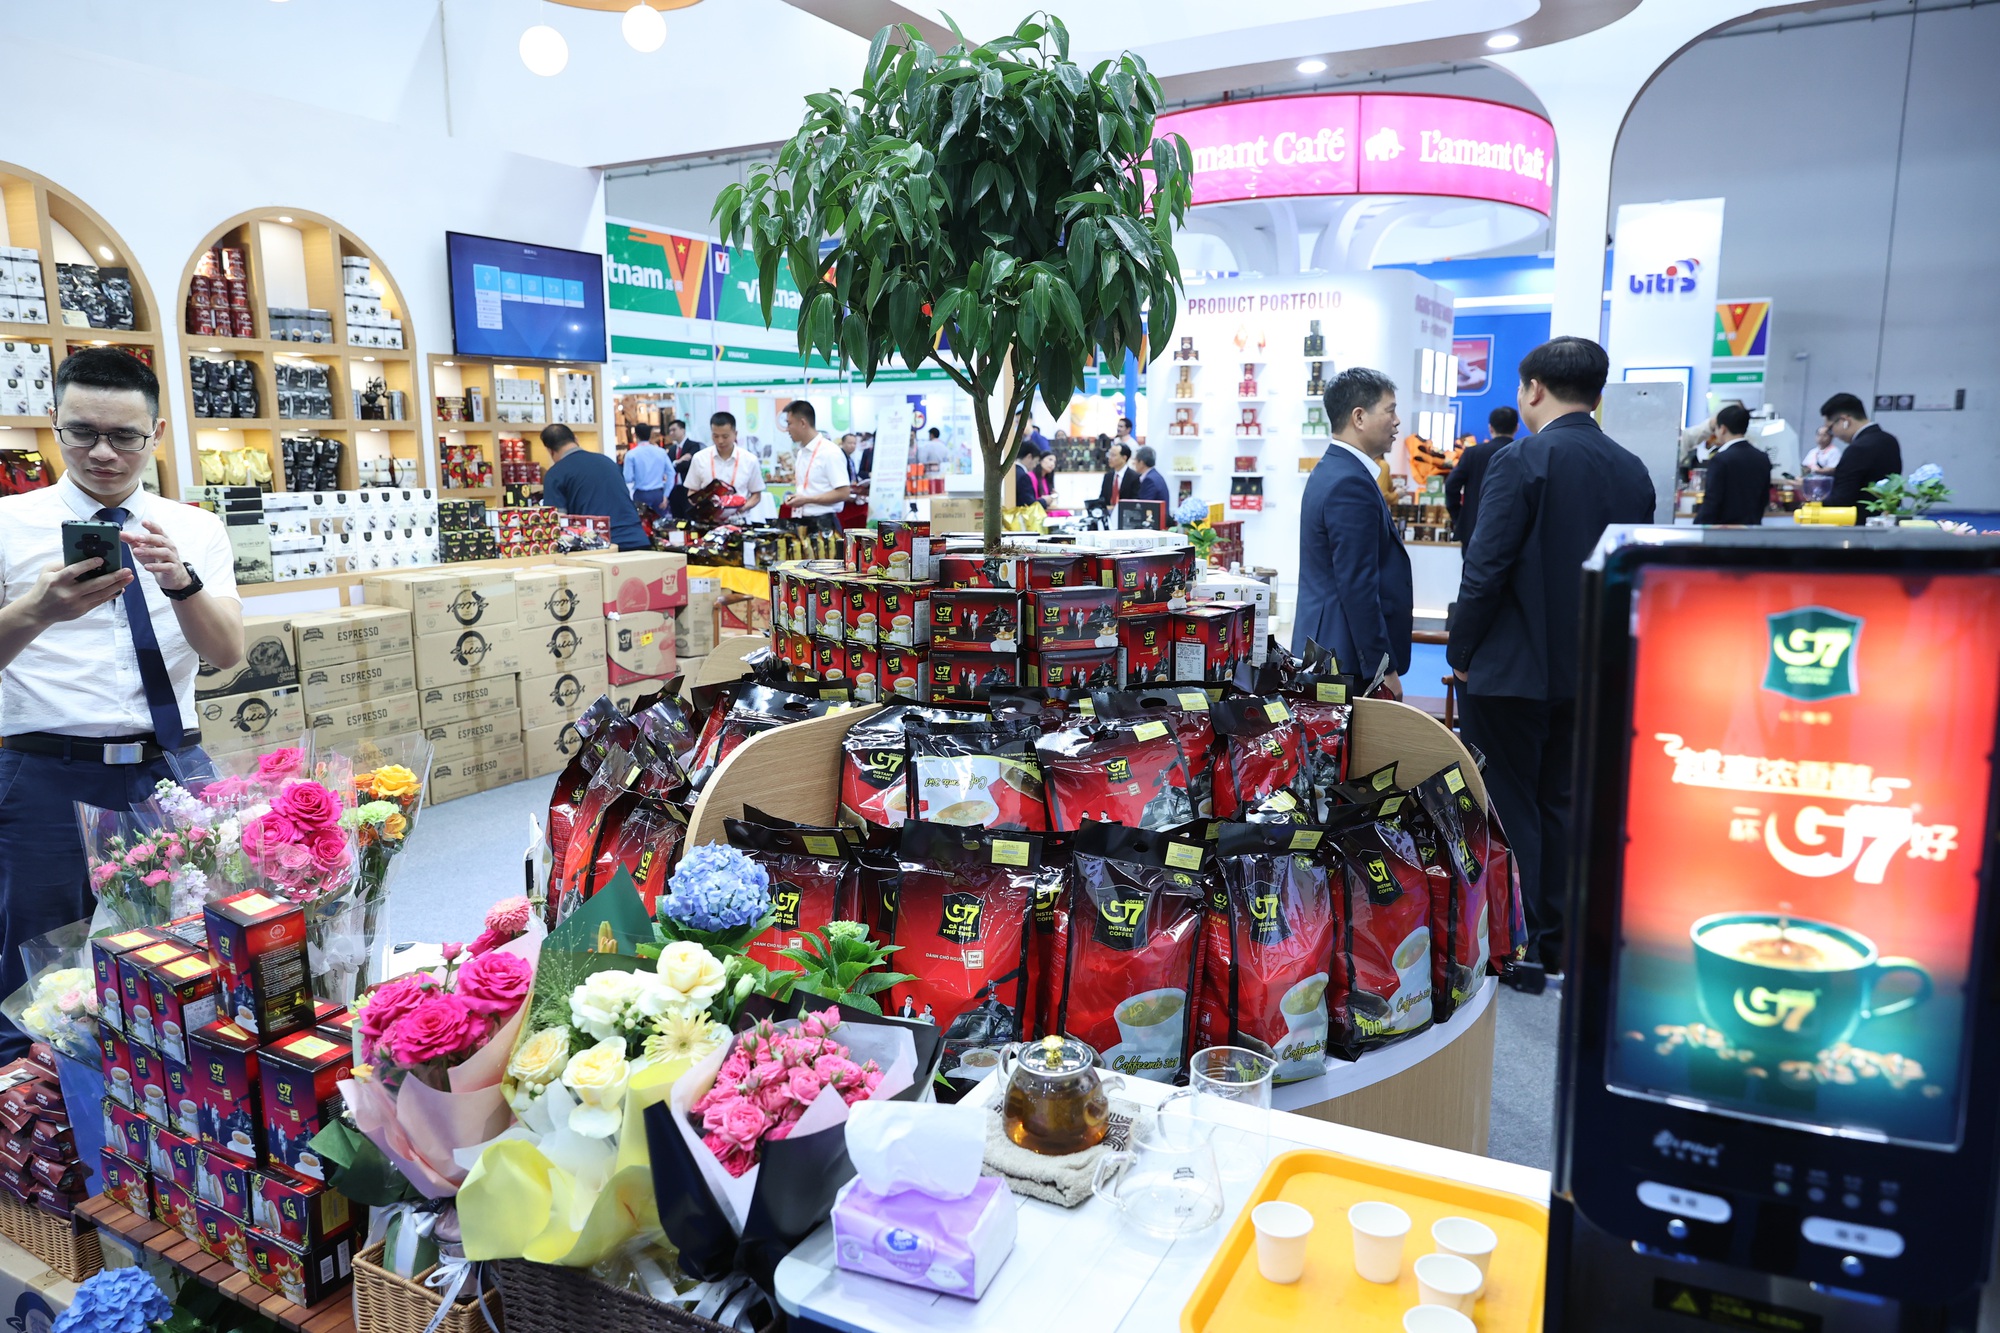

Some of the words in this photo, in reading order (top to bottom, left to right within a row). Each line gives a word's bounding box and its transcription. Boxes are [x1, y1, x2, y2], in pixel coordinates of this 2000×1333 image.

[1192, 135, 1270, 173] mant
[1273, 127, 1345, 165] Café
[606, 253, 664, 290] tnam
[1188, 295, 1255, 316] PRODUCT
[1260, 290, 1343, 312] PORTFOLIO
[882, 529, 895, 543] G7
[1051, 569, 1065, 580] G7
[1123, 571, 1137, 582] G7
[851, 592, 863, 603] G7
[885, 593, 898, 606] G7
[936, 606, 952, 617] G7
[1045, 606, 1059, 617] G7
[337, 626, 379, 642] ESPRESSO
[1773, 628, 1852, 668] G7
[851, 653, 862, 664] G7
[887, 657, 900, 669] G7
[340, 668, 382, 684] ESPRESSO
[935, 665, 951, 676] G7
[1048, 666, 1063, 677] G7
[453, 688, 488, 702] ESPRESSO
[347, 708, 388, 726] ESPRESSO
[458, 724, 493, 739] ESPRESSO
[462, 760, 498, 776] ESPRESSO
[869, 752, 904, 773] G7
[1106, 760, 1127, 773] G7
[1764, 804, 1914, 885] G7
[1906, 822, 1959, 861] 好
[1367, 860, 1389, 882] G7
[1101, 899, 1144, 925] G7
[1249, 895, 1279, 919] G7
[945, 904, 980, 925] G7
[1109, 930, 1133, 938] COFFEE
[1734, 986, 1816, 1033] G7
[1361, 1020, 1382, 1036] 100
[210, 1063, 223, 1076] G7
[1112, 1055, 1162, 1074] Coffeemix
[1163, 1057, 1178, 1069] 3in1
[277, 1082, 292, 1096] G7
[205, 1222, 217, 1233] G7
[255, 1253, 267, 1264] G7
